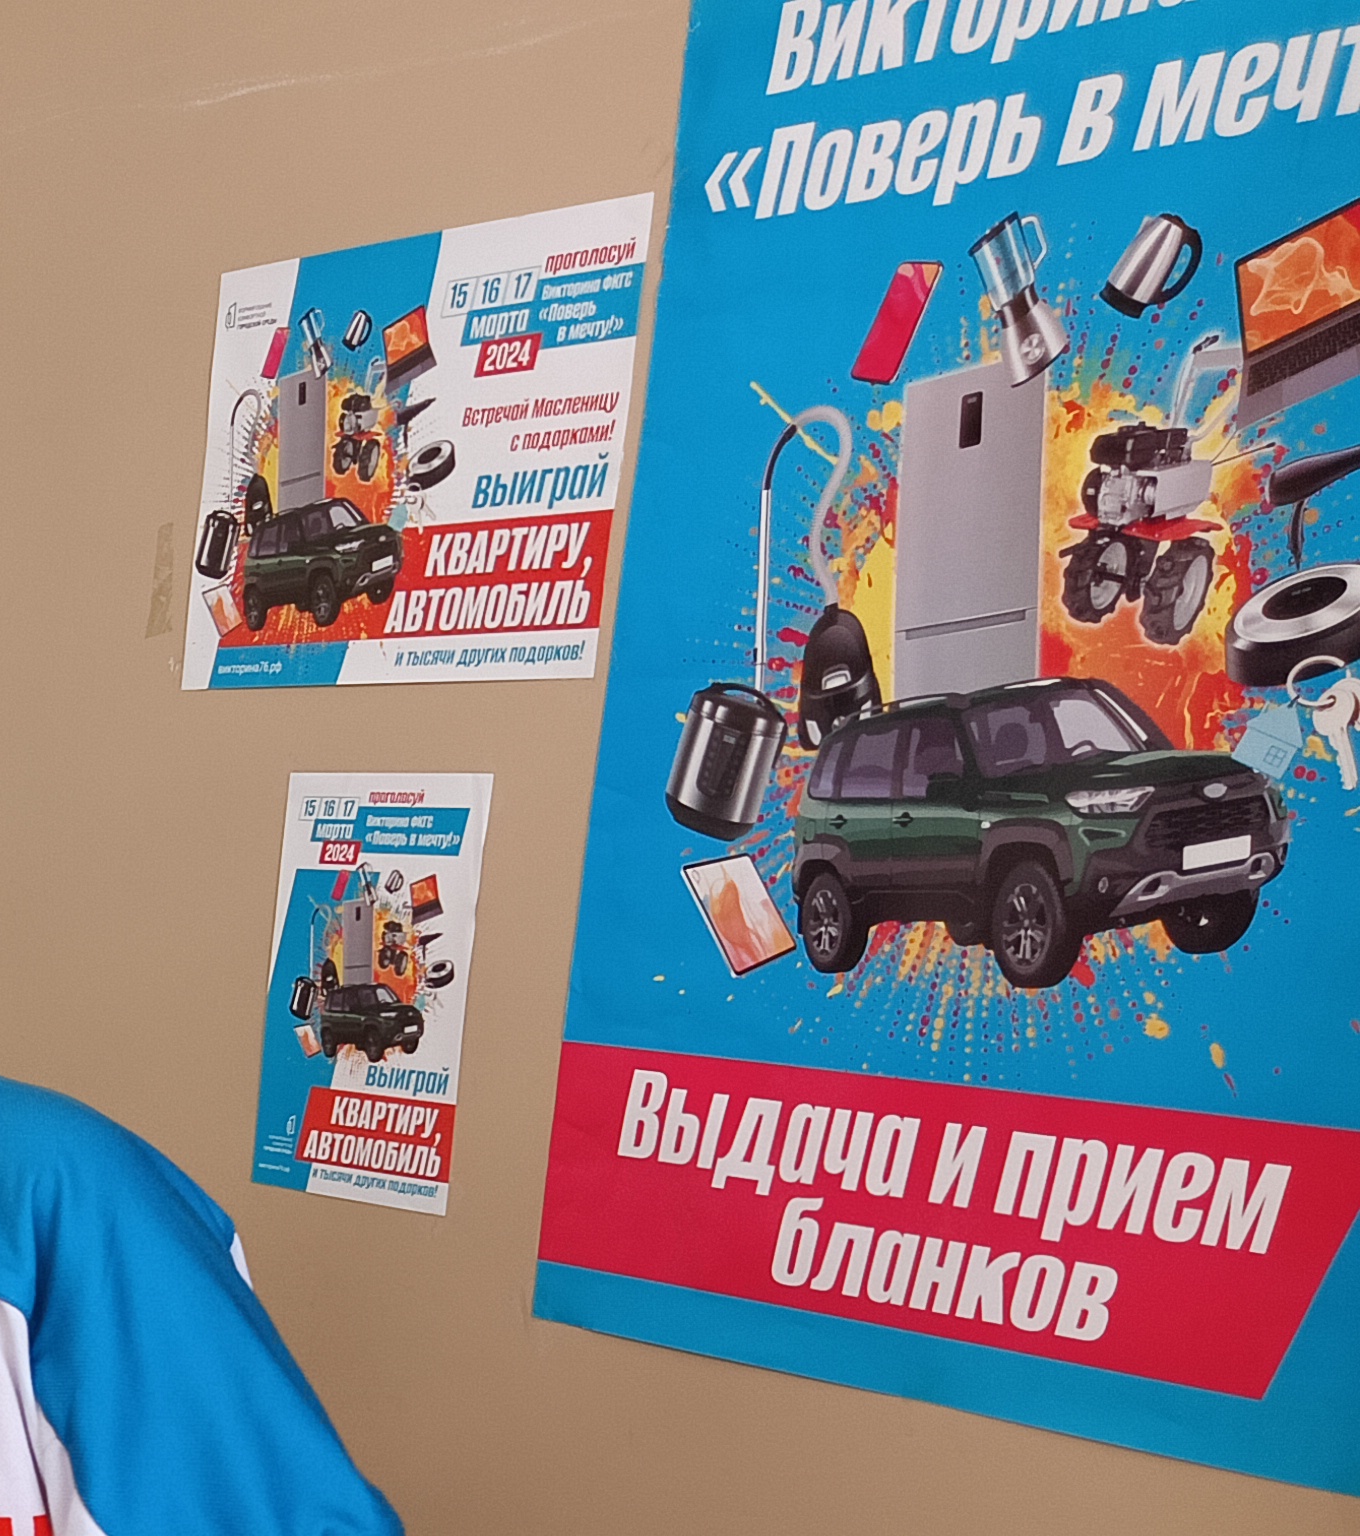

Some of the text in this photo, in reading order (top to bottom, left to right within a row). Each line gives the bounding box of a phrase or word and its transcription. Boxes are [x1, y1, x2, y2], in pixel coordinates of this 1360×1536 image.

[765, 0, 1197, 95] Виктор
[705, 93, 1043, 220] «Поверь
[1056, 72, 1124, 166] в
[545, 237, 636, 275] проголосуй
[450, 272, 533, 309] 15 16 17
[602, 271, 633, 292] ФКГС
[557, 327, 568, 343] в
[482, 339, 531, 372] 2024
[462, 391, 620, 428] Встречай Масленицу
[522, 419, 616, 452] подарками!
[424, 522, 593, 578] КВАРТИРУ,
[383, 579, 591, 634] АВТОМОБИЛЬ
[394, 642, 585, 668] и тысячи других подарков!
[304, 799, 356, 817] 15 16 17
[368, 789, 425, 807] проголосуй
[324, 843, 356, 862] 2024
[331, 1096, 442, 1147] КВАРТИРУ,
[303, 1129, 441, 1178] АВТОМОБИЛЬ
[617, 1067, 1293, 1255] Выдача и прием
[312, 1168, 439, 1198] и тысячи других подарков!
[771, 1196, 1119, 1343] бланков
